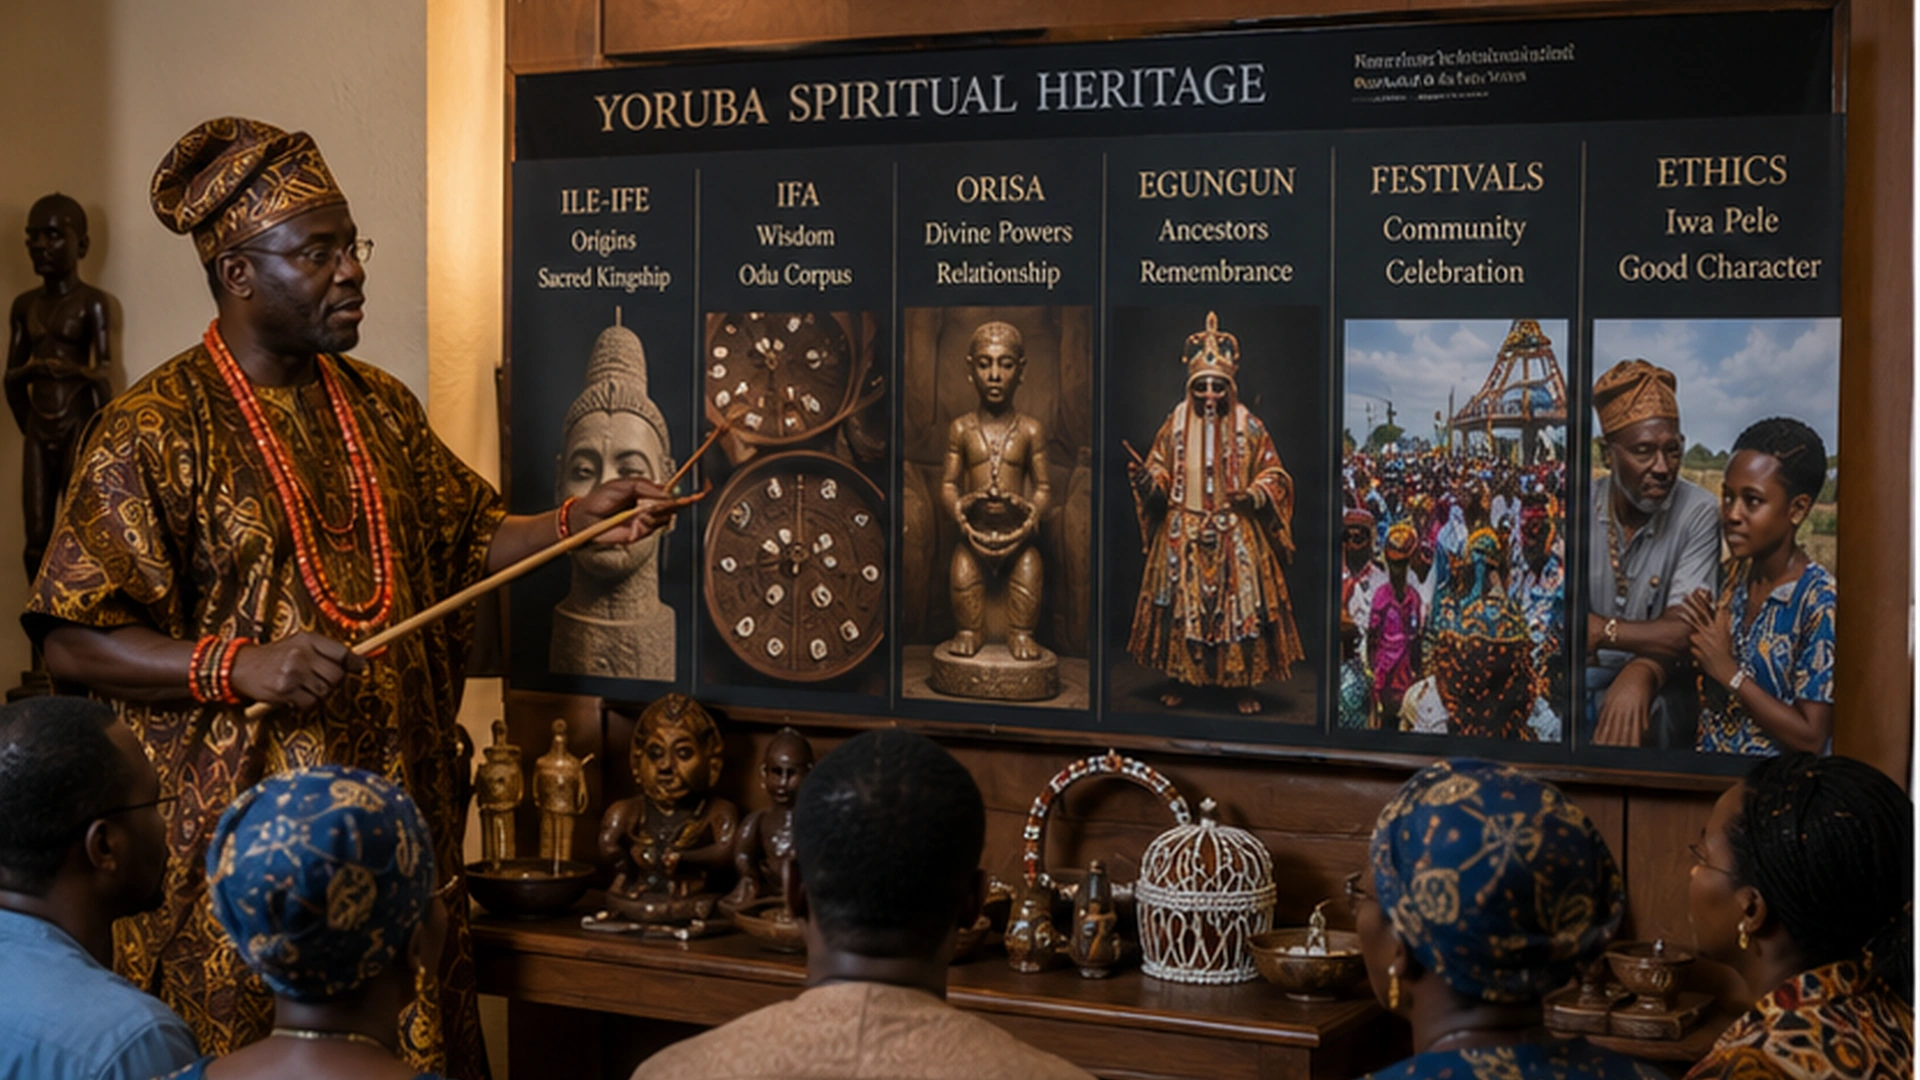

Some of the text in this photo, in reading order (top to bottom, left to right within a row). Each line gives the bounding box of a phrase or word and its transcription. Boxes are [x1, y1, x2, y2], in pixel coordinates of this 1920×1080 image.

[594, 63, 1266, 132] YORUBA SPIRITUAL HERITAGE
[1139, 167, 1296, 199] EGUNGUN
[1371, 162, 1544, 194] FESTIVALS
[1658, 154, 1787, 188] ETHICS
[561, 186, 650, 215] ILE-IFE
[777, 181, 820, 208] IFA
[956, 174, 1046, 203] ORISA
[925, 220, 1073, 245] Divine Powers
[1158, 218, 1269, 242] Ancestors
[1383, 214, 1527, 247] Community
[1667, 205, 1779, 234] Iwa Pele
[571, 229, 637, 257] Origins
[756, 224, 835, 247] Wisdom
[538, 265, 671, 293] Sacred Kingship
[738, 263, 853, 292] Odu Corpus
[937, 260, 1061, 290] Relationship
[1141, 258, 1293, 283] Remembrance
[1385, 258, 1525, 285] Celebration
[1619, 253, 1822, 281] Good Character
